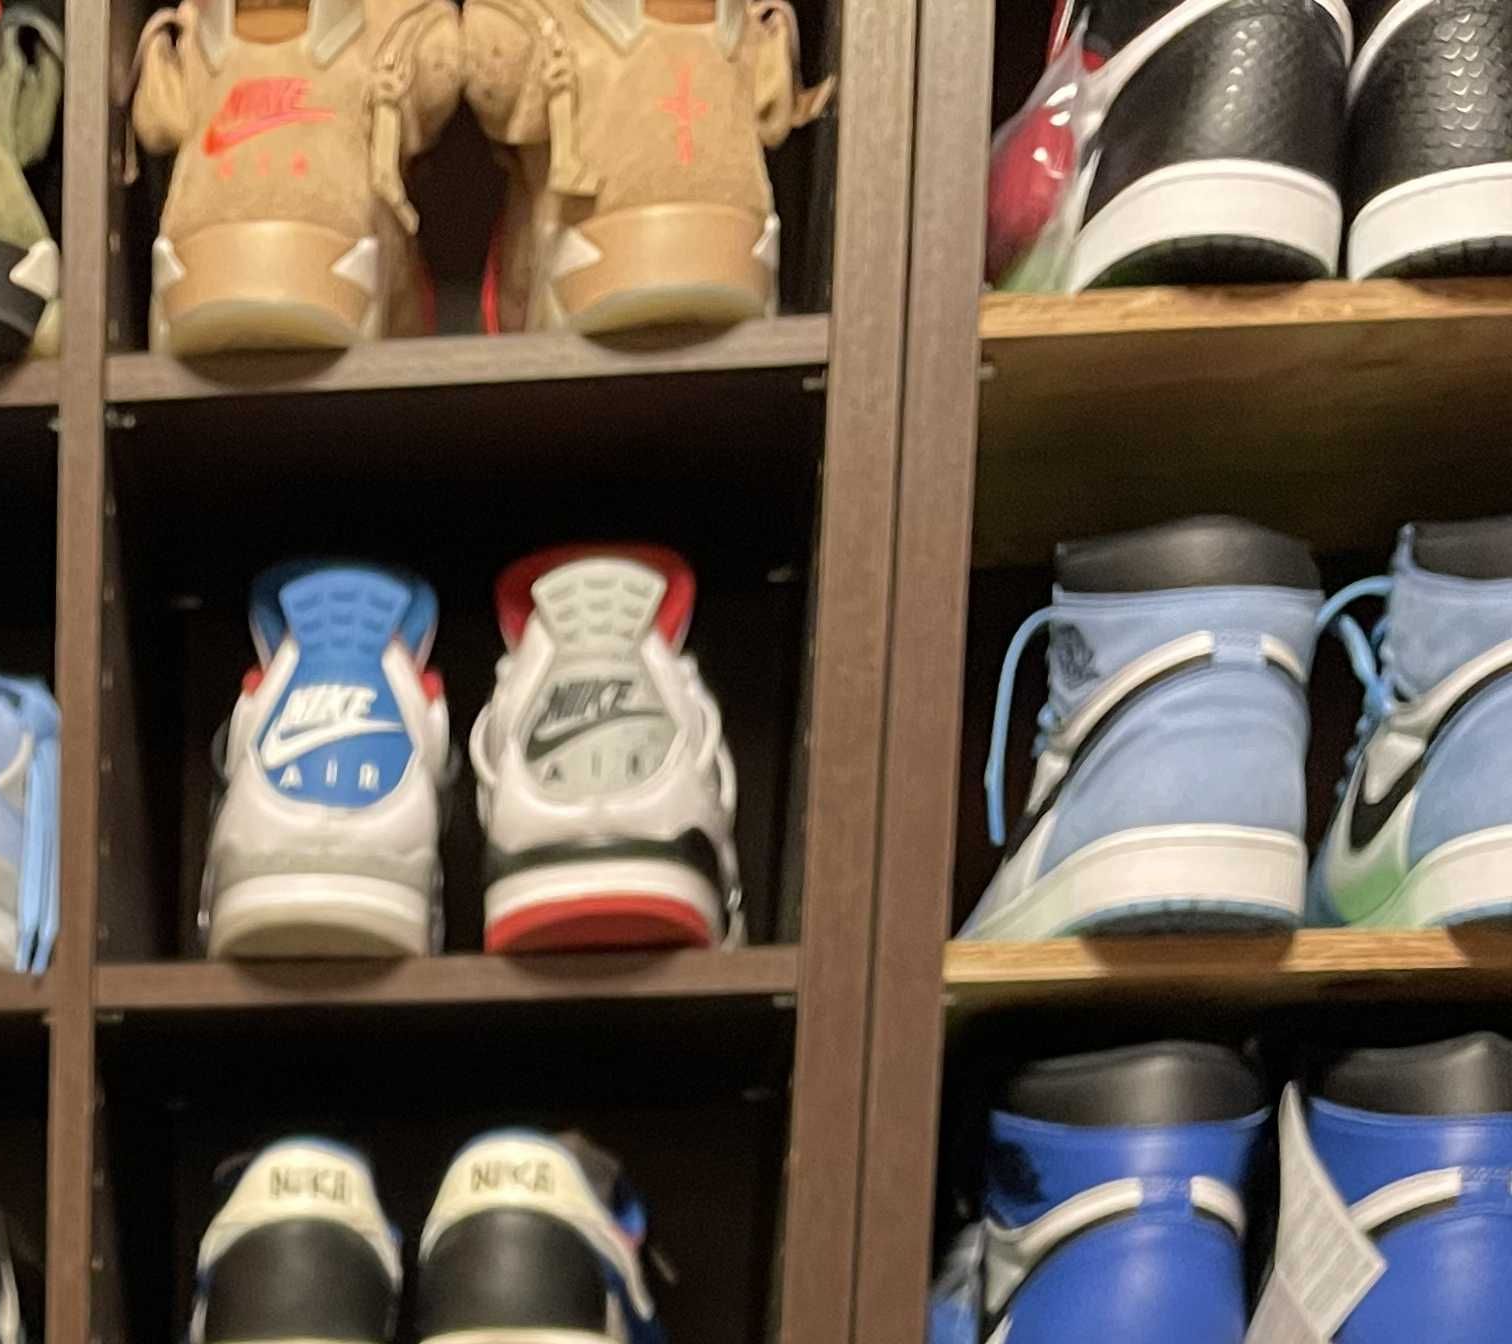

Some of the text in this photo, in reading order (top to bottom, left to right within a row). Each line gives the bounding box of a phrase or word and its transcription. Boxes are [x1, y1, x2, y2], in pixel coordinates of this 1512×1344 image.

[281, 684, 378, 724] NIKE
[543, 680, 631, 724] NIKE
[279, 759, 380, 791] AIR
